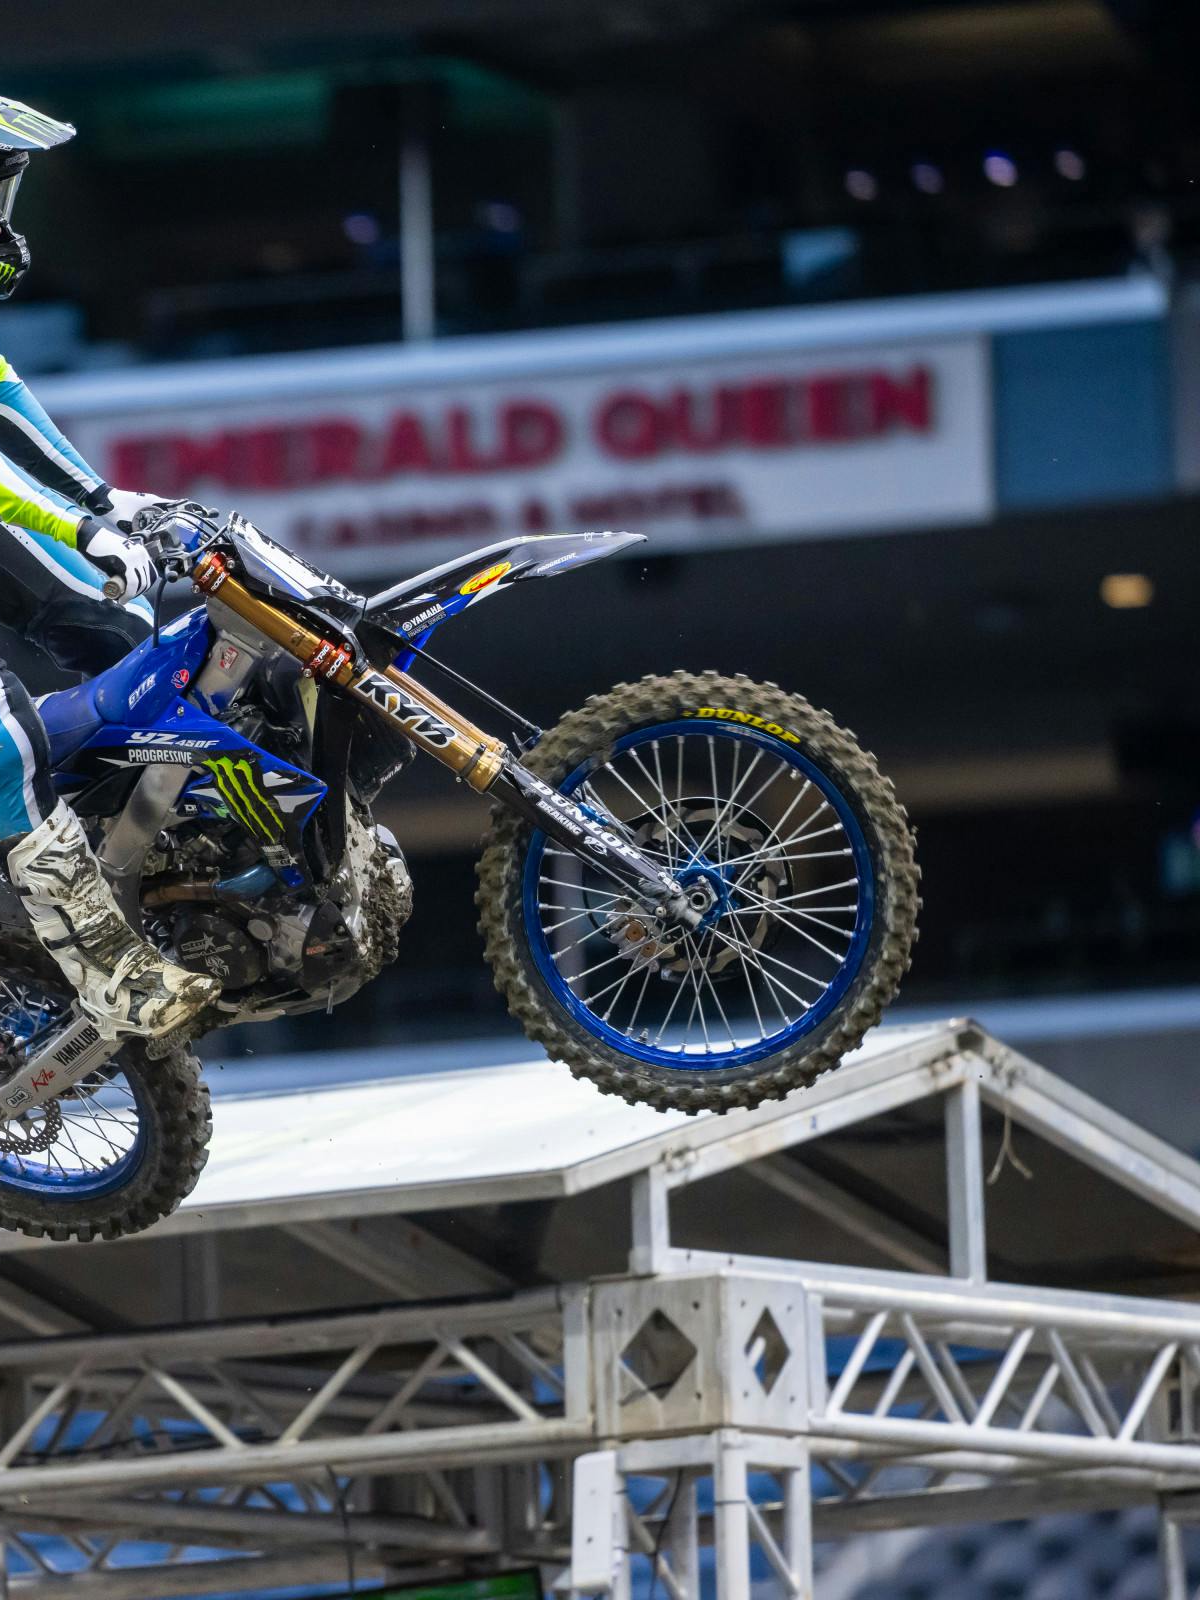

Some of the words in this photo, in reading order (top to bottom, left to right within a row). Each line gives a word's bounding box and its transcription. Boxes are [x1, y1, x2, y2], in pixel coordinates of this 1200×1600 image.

[111, 398, 566, 498] EMERALD
[591, 364, 933, 460] QUEEN
[411, 603, 444, 627] YAMAHA
[696, 706, 801, 744] DUNLOP
[128, 748, 193, 765] PROGRESSIVE
[530, 780, 641, 860] DUNLOP
[536, 800, 584, 836] BRAKING
